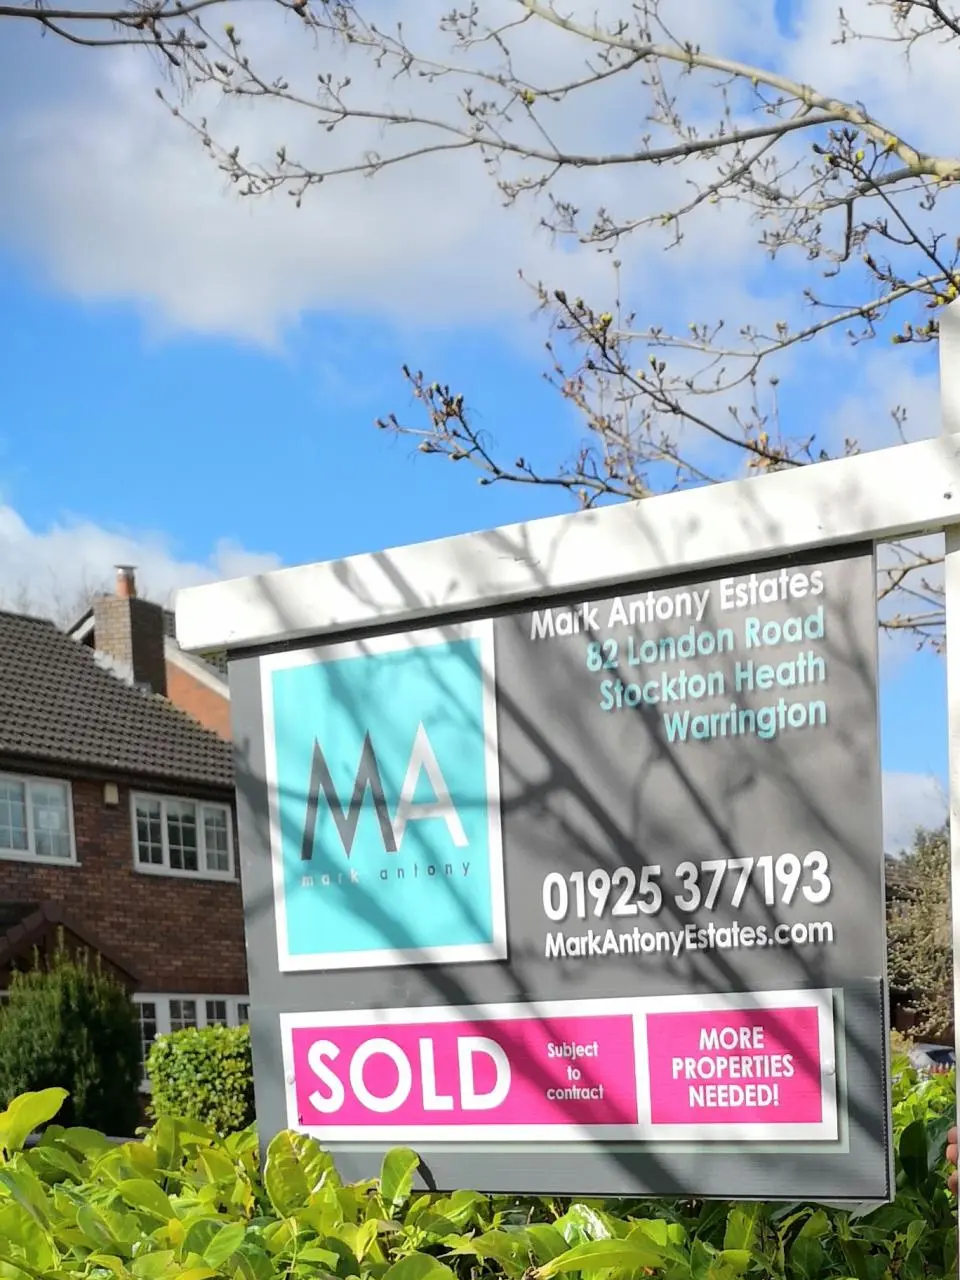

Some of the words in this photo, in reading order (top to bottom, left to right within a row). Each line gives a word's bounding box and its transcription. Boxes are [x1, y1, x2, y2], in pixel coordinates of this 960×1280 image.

[531, 602, 600, 641] Mark
[608, 586, 710, 628] Antony
[720, 568, 824, 610] Estates
[586, 637, 620, 672] 82
[627, 624, 734, 667] London
[745, 605, 825, 648] Road
[600, 666, 725, 711] Stockton
[735, 650, 826, 692] Heath
[664, 698, 827, 743] Warrington
[300, 719, 470, 861] MA
[300, 868, 360, 888] mark
[379, 861, 471, 881] antony
[542, 864, 662, 922] 01925
[674, 850, 832, 913] 377193
[545, 919, 834, 958] MarkAntonyEstates.com
[547, 1041, 599, 1060] Subject
[699, 1026, 765, 1050] MORE
[307, 1036, 512, 1114] SOLD
[566, 1066, 581, 1081] to
[671, 1054, 795, 1080] PROPERTIES
[546, 1084, 605, 1101] contract
[688, 1083, 780, 1108] NEEDED!
